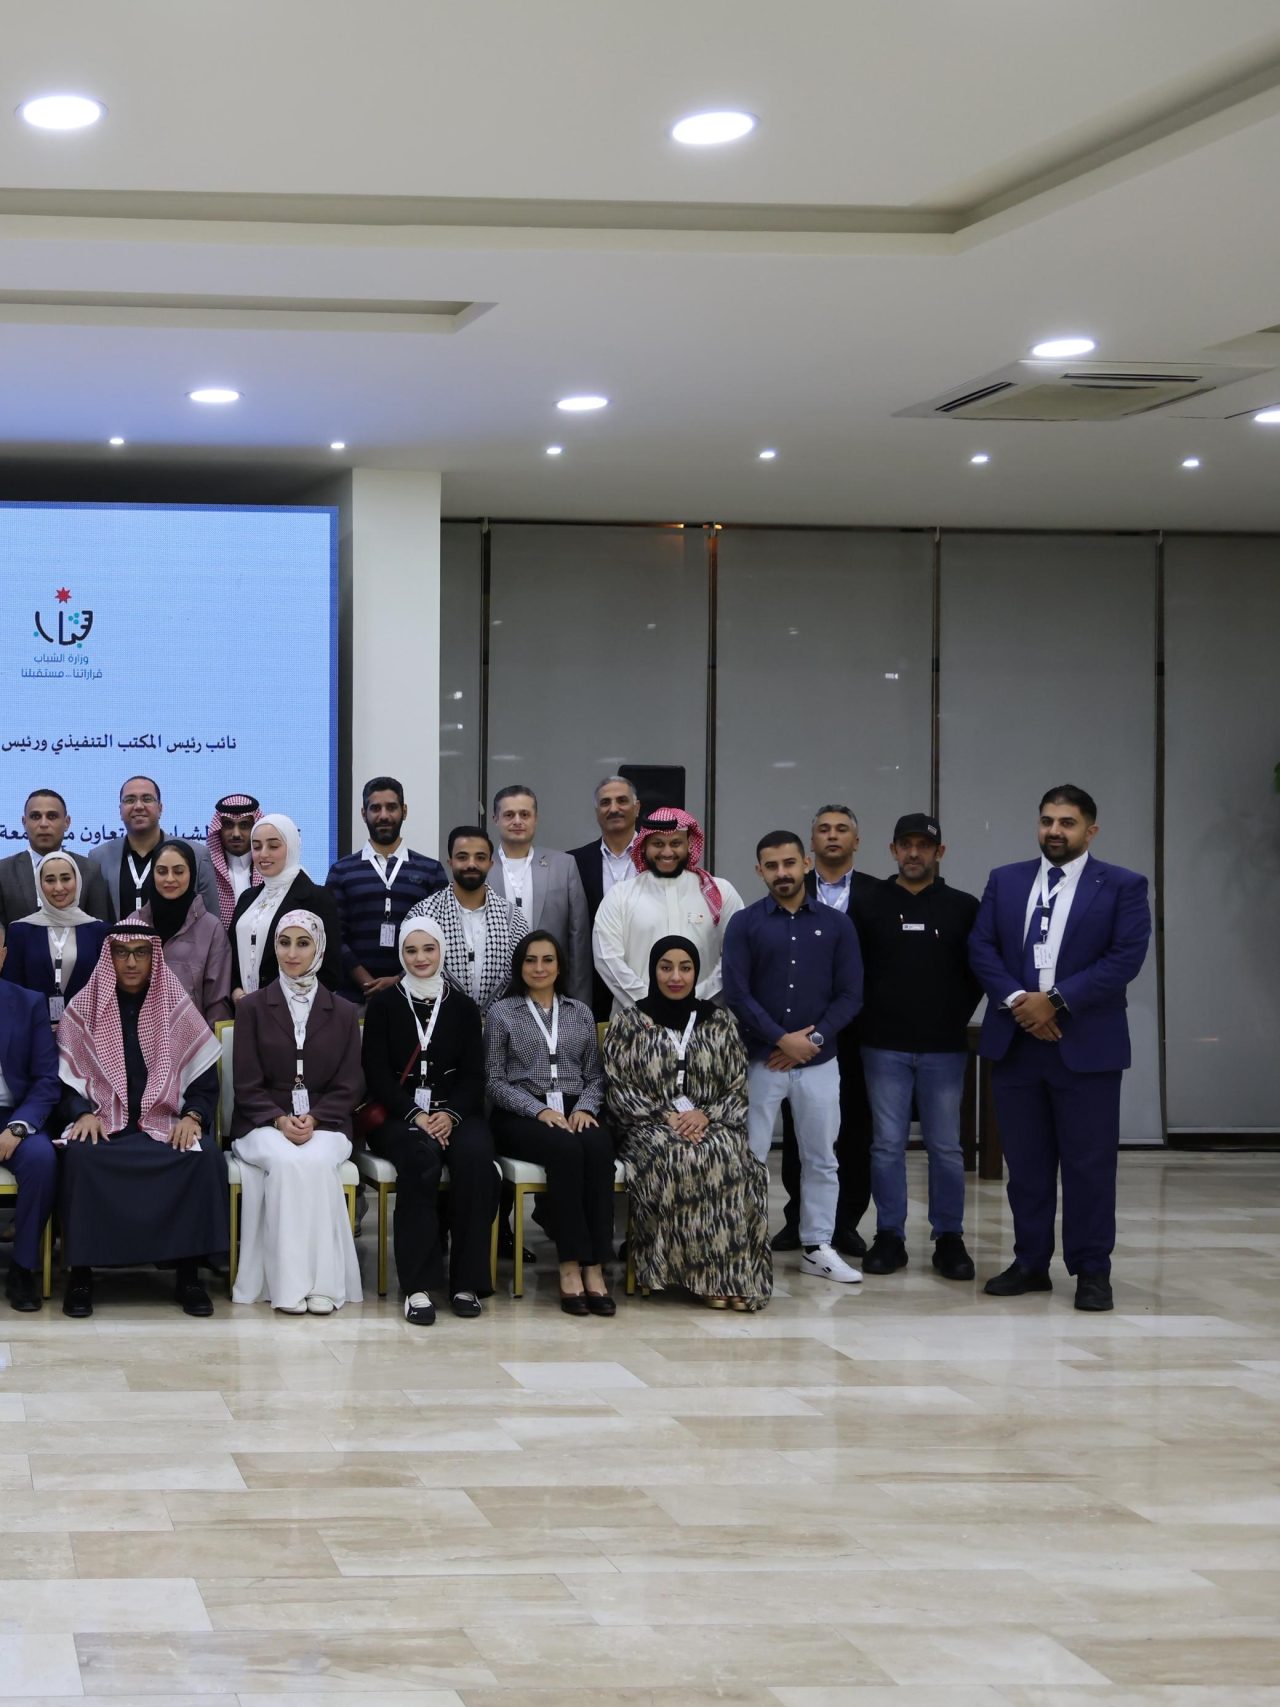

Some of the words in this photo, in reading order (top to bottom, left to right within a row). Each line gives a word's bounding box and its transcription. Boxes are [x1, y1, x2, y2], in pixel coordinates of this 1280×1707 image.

[33, 653, 65, 664] الشباب
[68, 654, 89, 665] وزارة
[21, 667, 65, 679] مستقبلنا
[2, 736, 48, 752] ورئيس
[51, 734, 113, 754] التنفيذي
[118, 734, 162, 752] المكتب
[167, 736, 202, 753] رئيس
[206, 735, 237, 752] نائب
